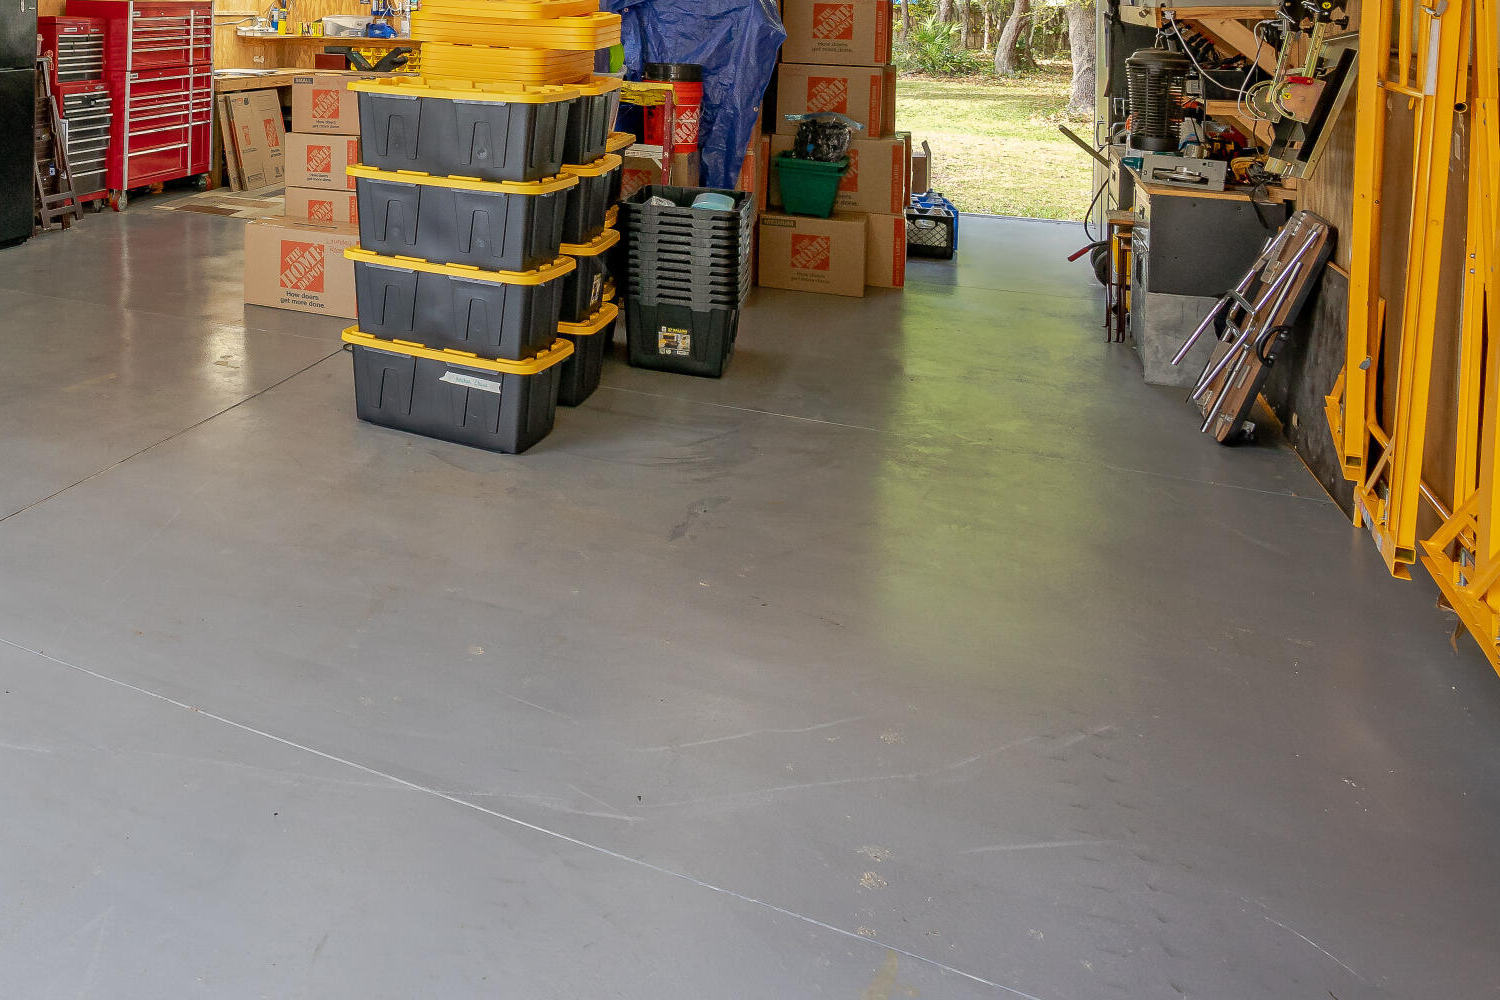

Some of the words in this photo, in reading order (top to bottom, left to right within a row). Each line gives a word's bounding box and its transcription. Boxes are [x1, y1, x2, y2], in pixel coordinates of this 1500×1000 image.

[284, 246, 304, 265] THE
[280, 243, 324, 289] HOME
[301, 291, 319, 301] doers
[308, 300, 326, 309] done.
